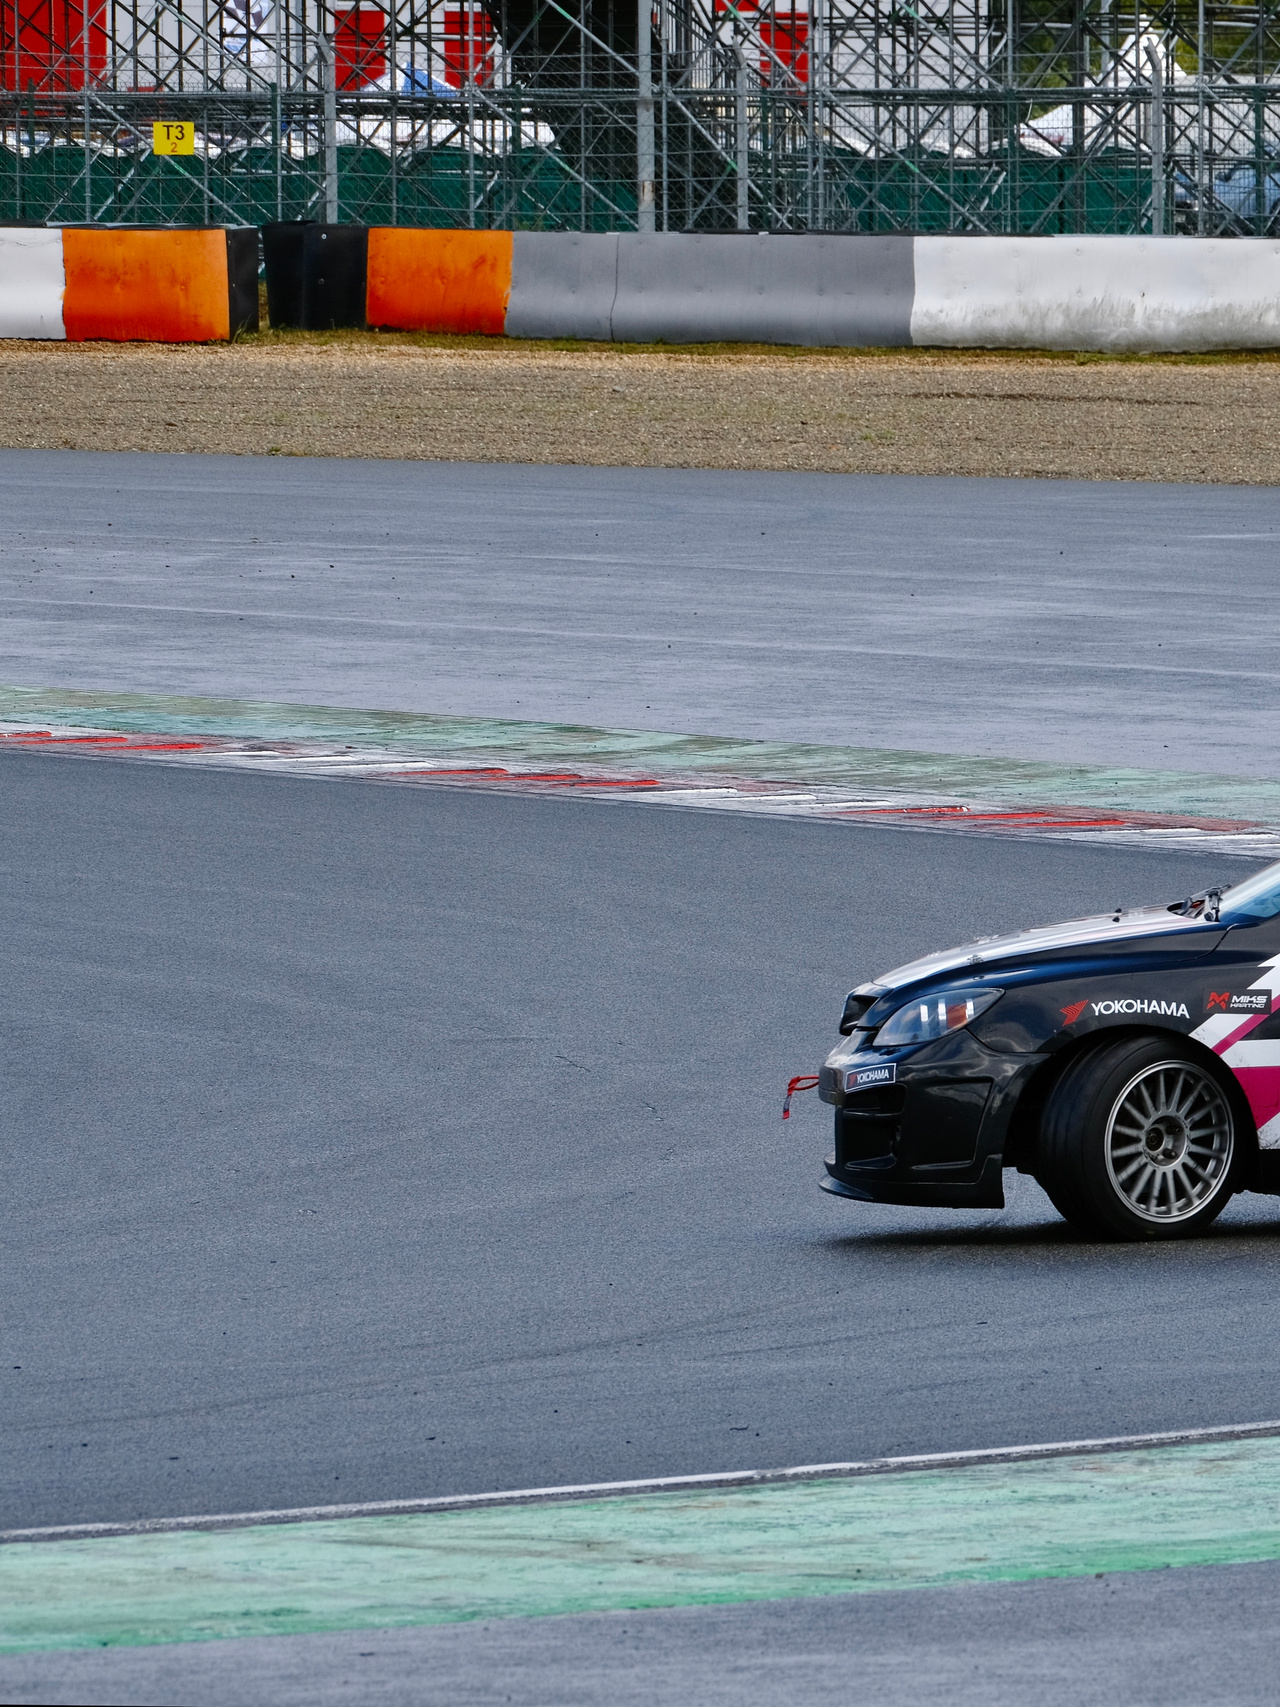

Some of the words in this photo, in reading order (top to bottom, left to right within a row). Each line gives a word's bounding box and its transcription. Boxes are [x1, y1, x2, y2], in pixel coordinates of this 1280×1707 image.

[162, 124, 185, 141] T3
[170, 141, 178, 153] 2
[1231, 995, 1269, 1004] MIKS
[1091, 999, 1190, 1019] YOKOHAMA
[856, 1069, 890, 1084] YOKOHAMA
